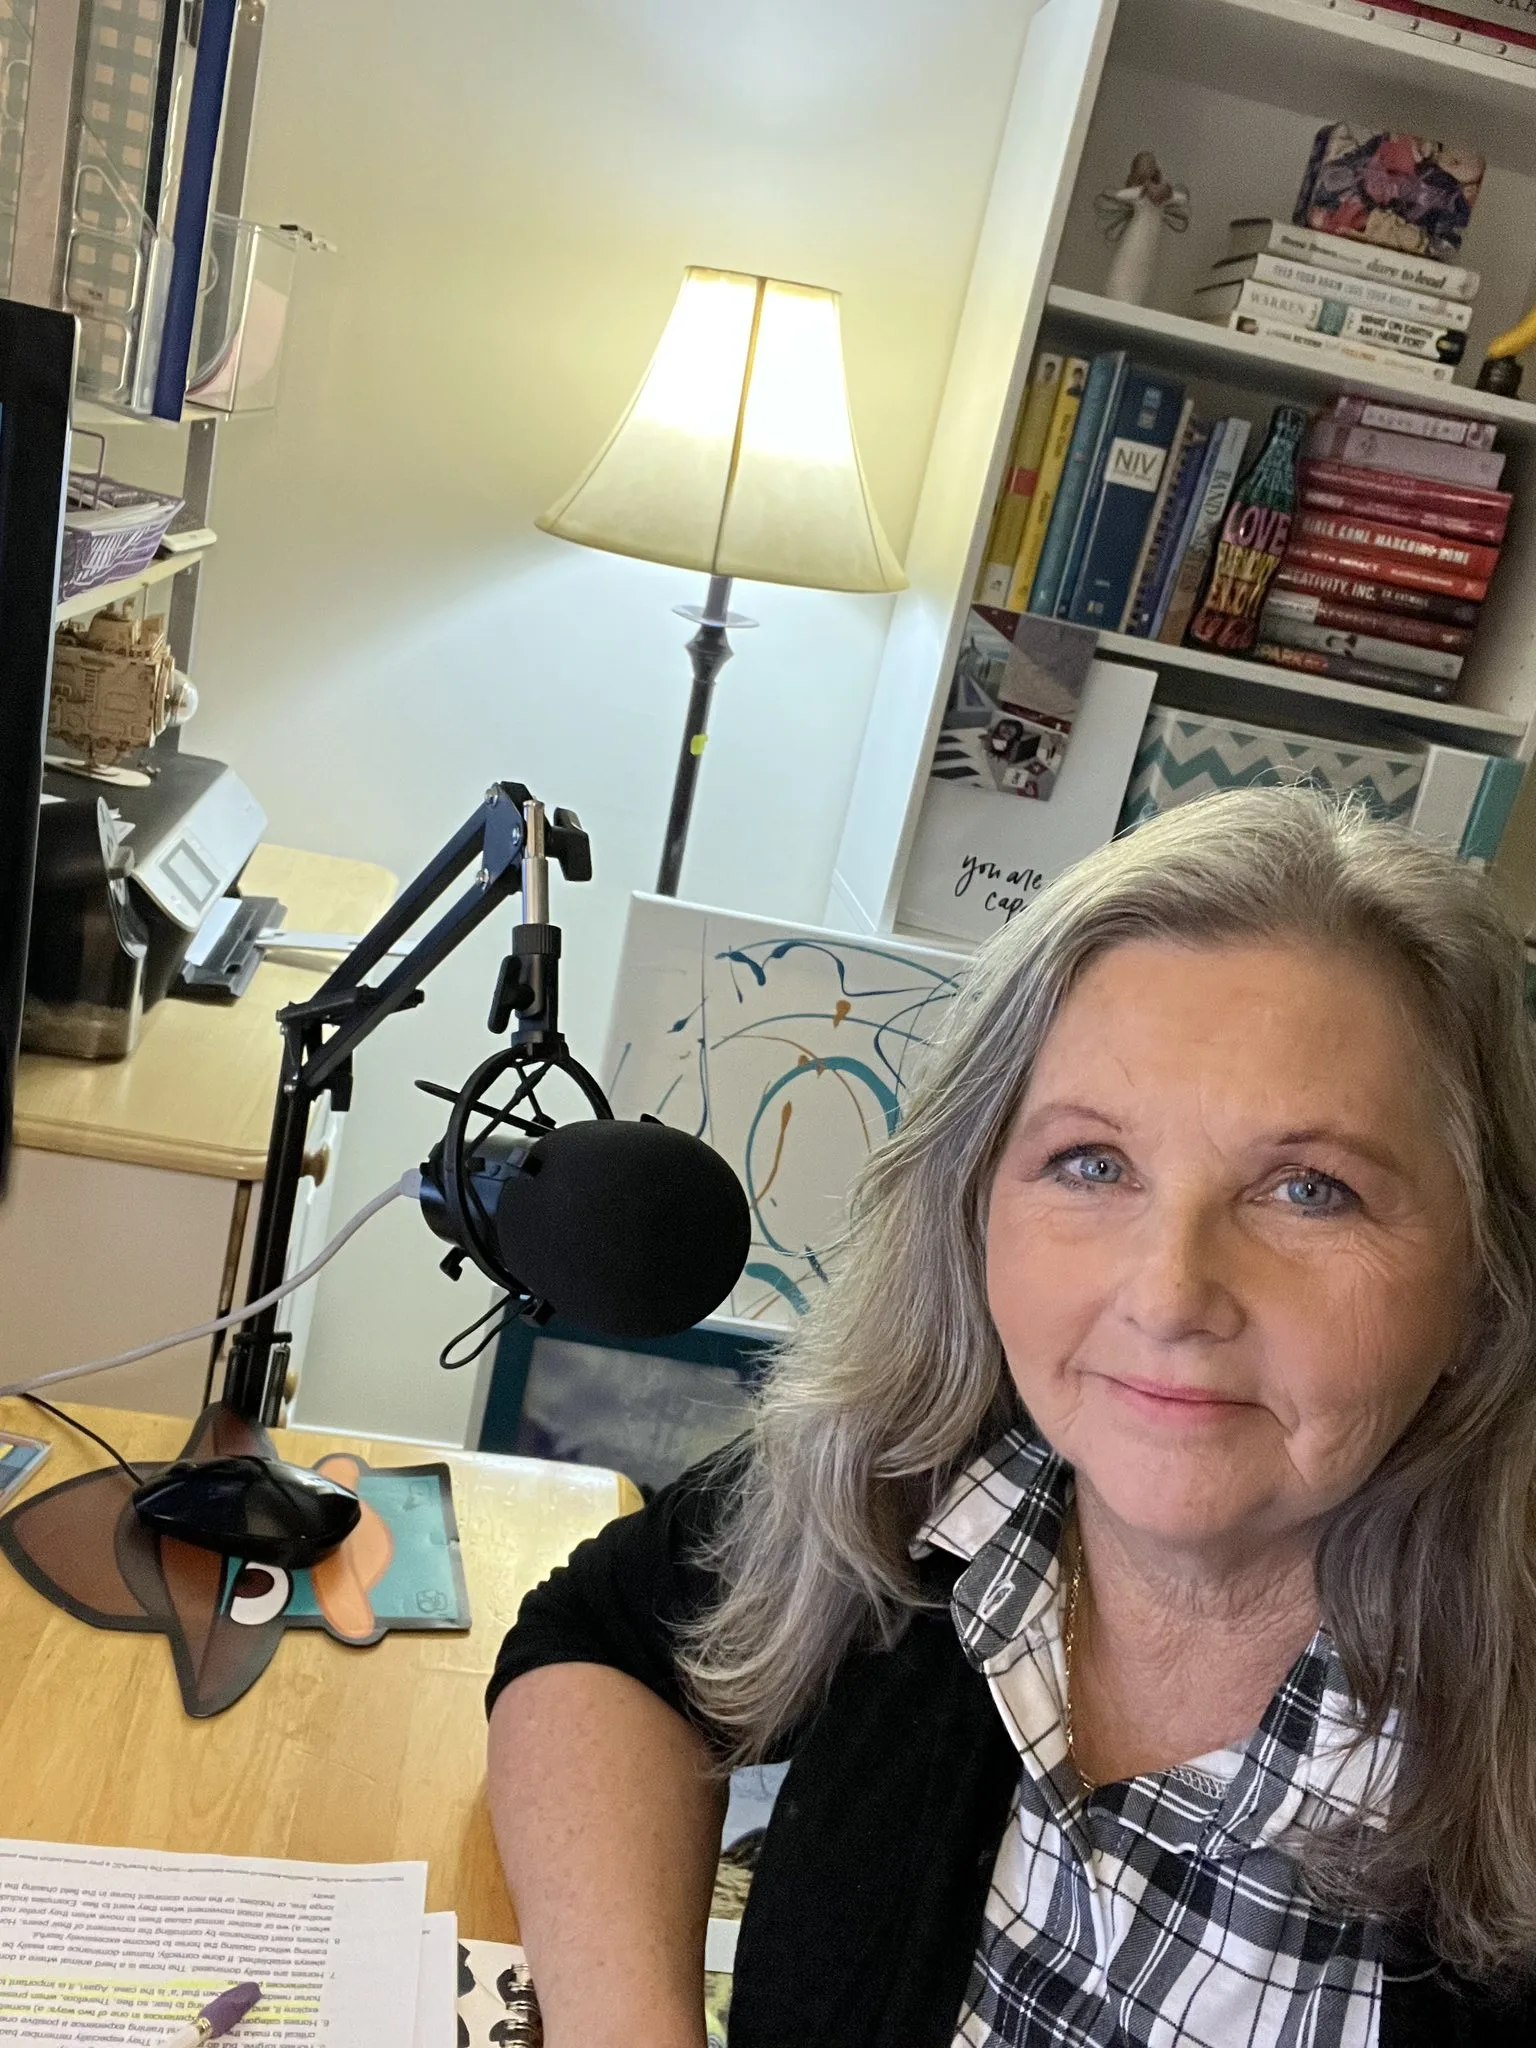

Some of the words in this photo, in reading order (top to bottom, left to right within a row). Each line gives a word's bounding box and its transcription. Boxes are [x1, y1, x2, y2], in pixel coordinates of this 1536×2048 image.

[1366, 257, 1399, 278] dare
[1401, 268, 1415, 281] to
[1415, 269, 1447, 290] lead
[1251, 291, 1305, 314] WARREN
[1361, 313, 1387, 330] WHAT
[1388, 319, 1403, 332] ON
[1404, 322, 1434, 339] EARTH
[1115, 448, 1157, 474] NIV
[1204, 468, 1230, 516] BAND
[1224, 501, 1291, 555] LOVE
[1351, 582, 1376, 600] INC.
[955, 855, 1000, 897] you
[1006, 869, 1042, 891] are
[82, 1889, 96, 1897] the
[52, 1921, 72, 1929] their
[17, 1941, 44, 1949] easily
[297, 1937, 329, 1945] Horses
[67, 1946, 119, 1956] dominance
[221, 1942, 256, 1951] causing
[294, 1947, 327, 1955] training
[60, 1958, 93, 1966] animal
[244, 1968, 270, 1977] easily
[8, 1979, 55, 1988] important
[140, 1987, 154, 1995] the
[182, 1989, 200, 1997] that
[97, 2010, 107, 2018] of
[20, 2017, 58, 2025] positive
[70, 2021, 125, 2030] experience
[283, 2019, 317, 2027] Horses
[128, 2023, 164, 2034] training
[20, 2031, 72, 2041] remember
[75, 2034, 124, 2043] especially
[126, 2037, 150, 2046] They
